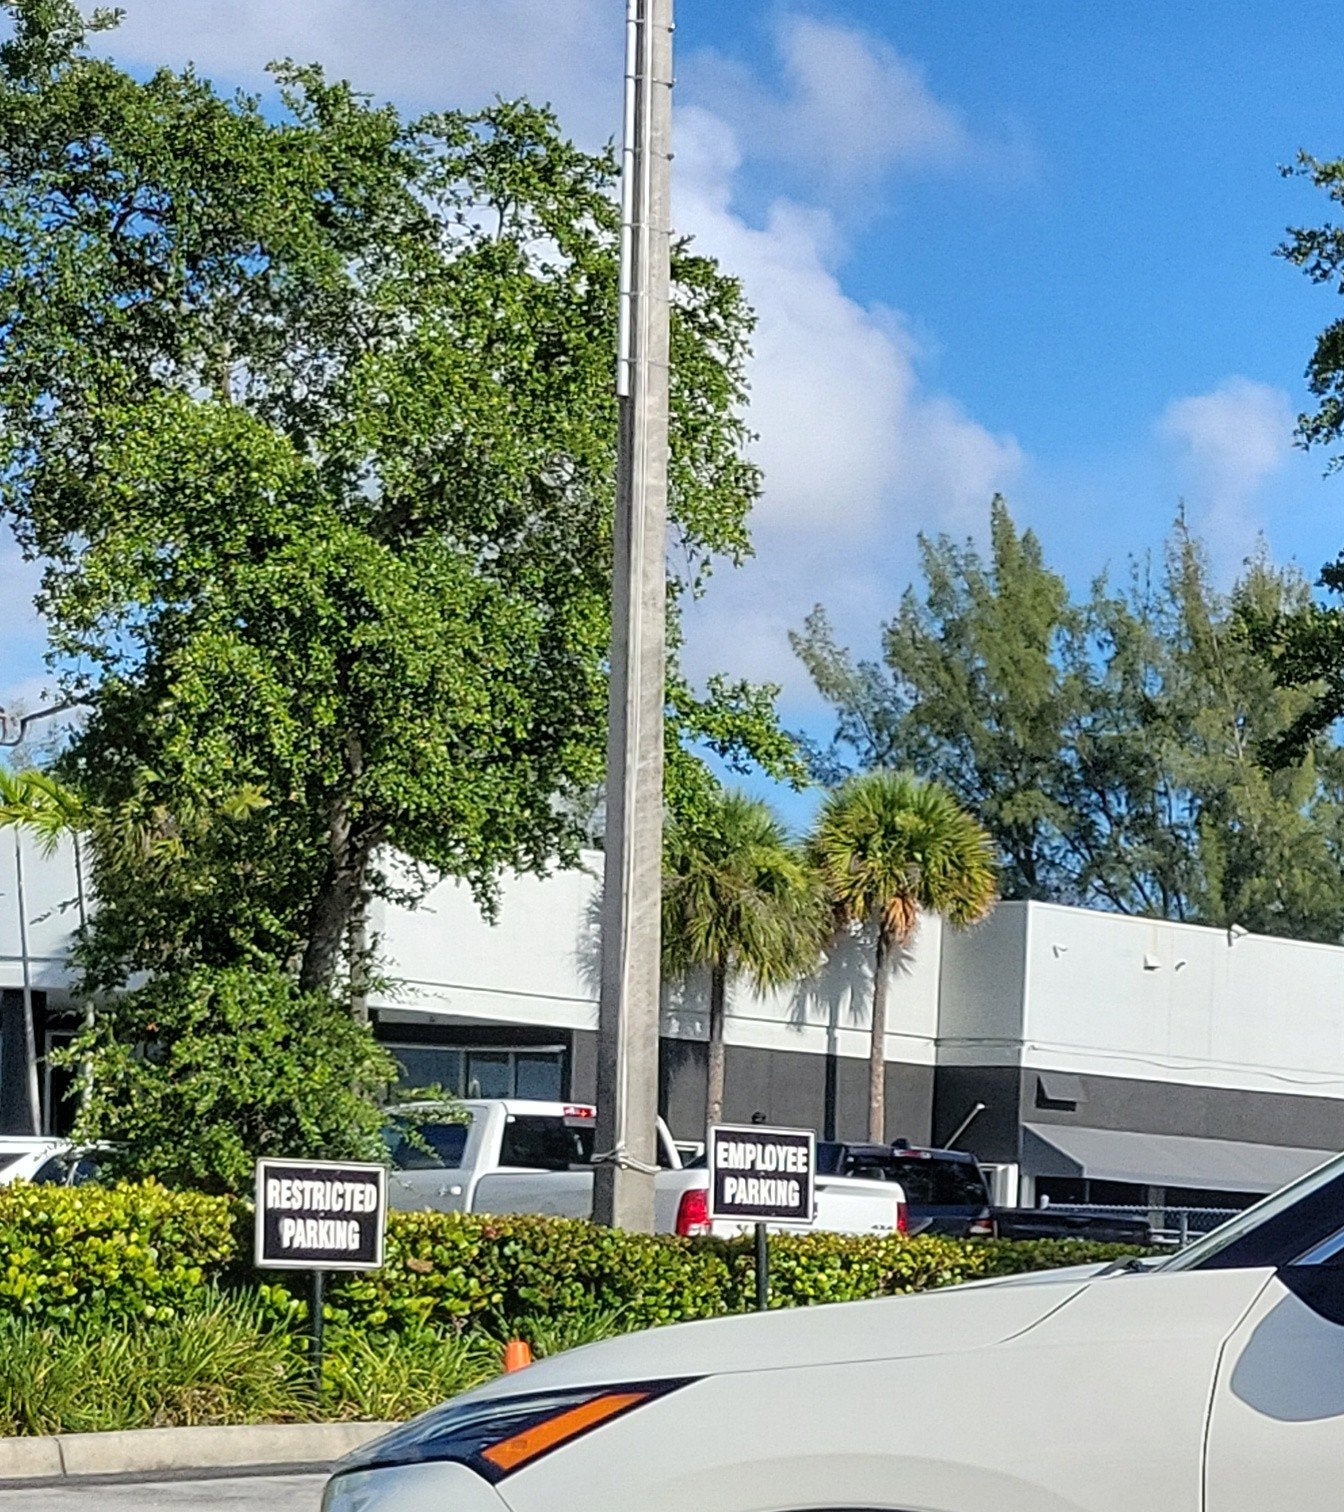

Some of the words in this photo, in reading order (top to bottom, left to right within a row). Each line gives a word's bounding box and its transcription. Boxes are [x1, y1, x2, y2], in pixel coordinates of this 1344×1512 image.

[716, 1141, 808, 1173] EMPLOYEE
[266, 1178, 378, 1213] RESTRICTED
[724, 1176, 800, 1208] PARKING
[280, 1217, 361, 1251] PARKING
